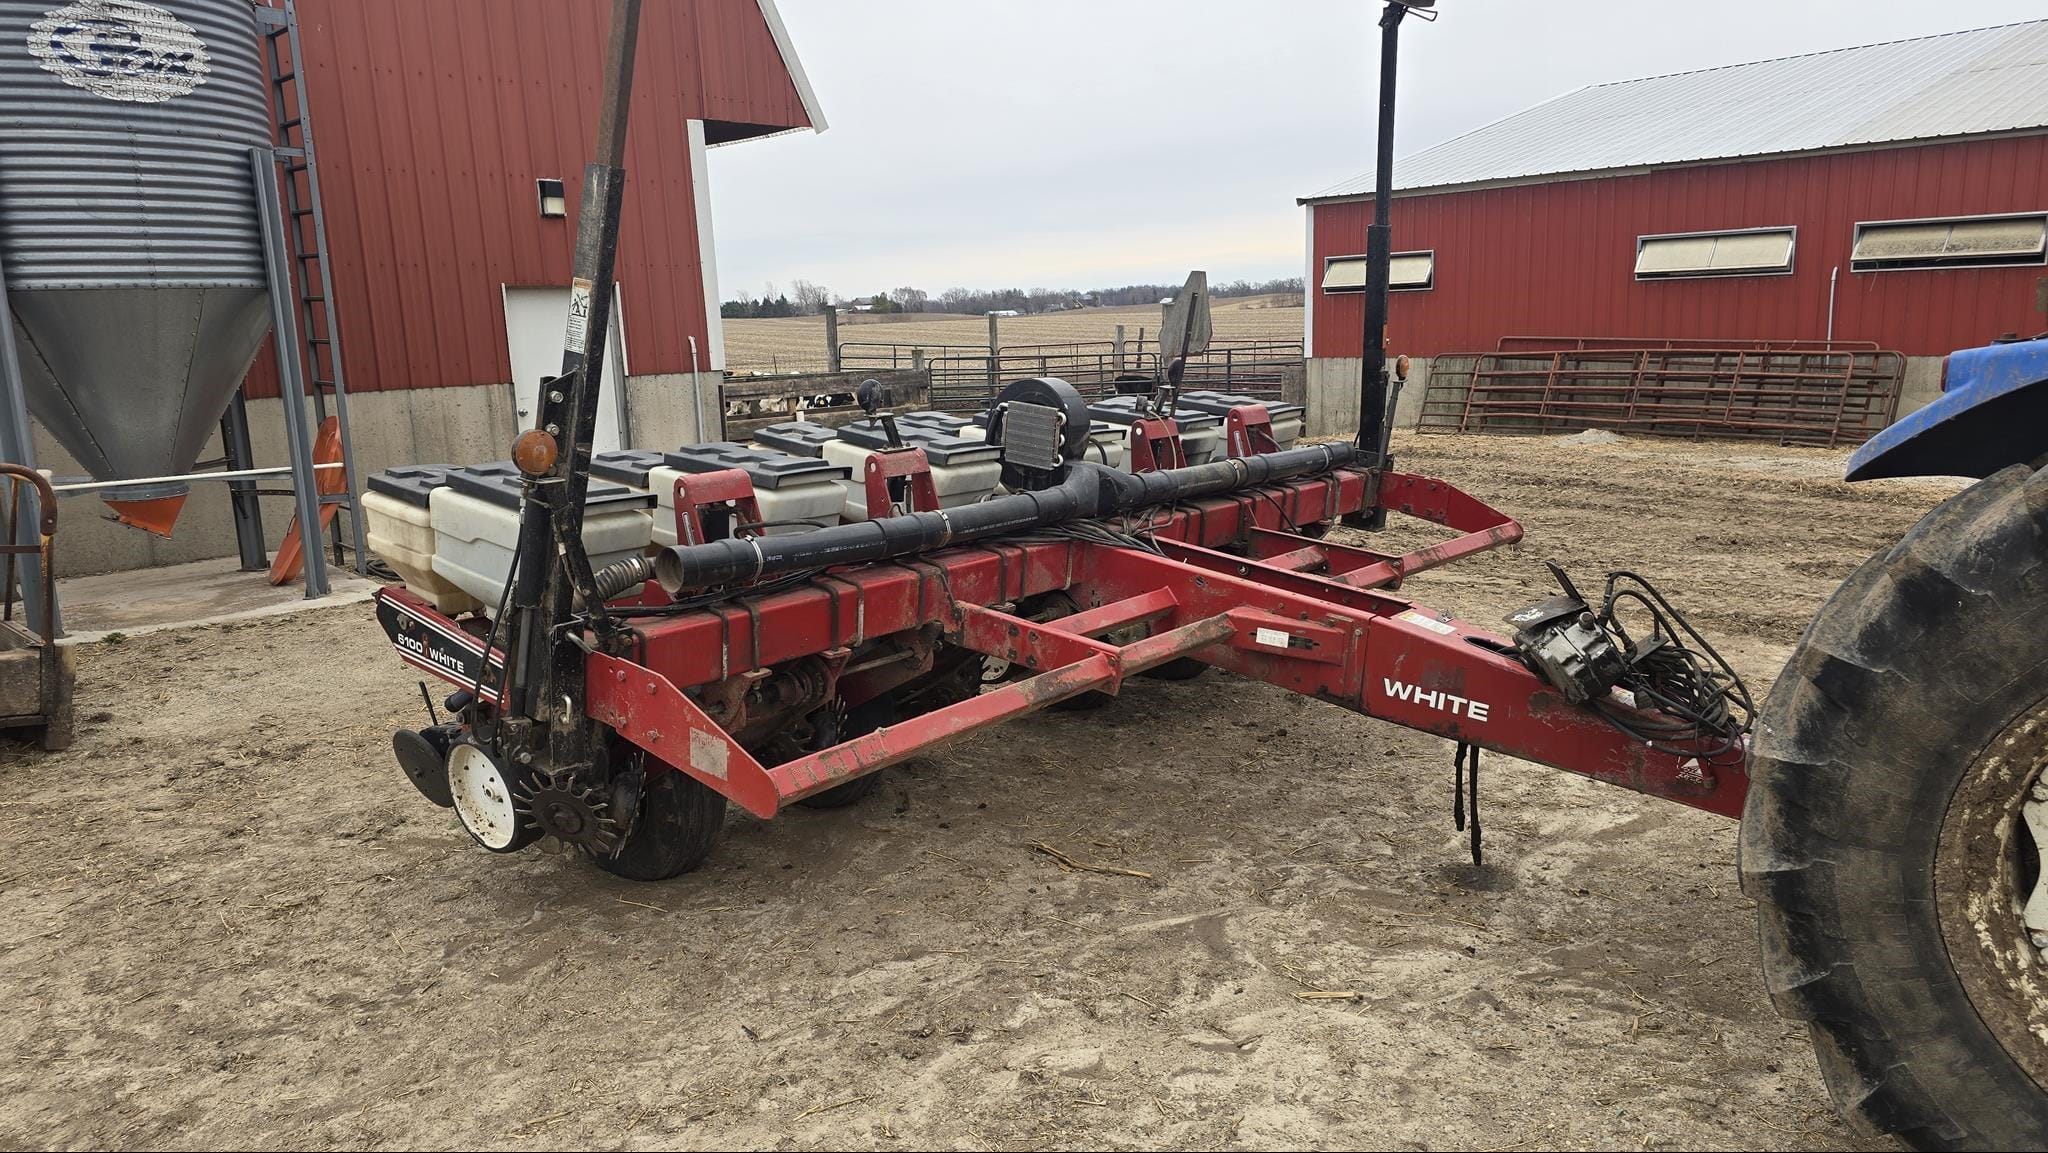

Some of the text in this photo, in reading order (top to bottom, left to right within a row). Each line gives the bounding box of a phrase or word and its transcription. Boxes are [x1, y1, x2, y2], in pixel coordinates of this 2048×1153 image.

[397, 633, 465, 674] 6100 WHITE
[1384, 678, 1490, 722] WHITE
